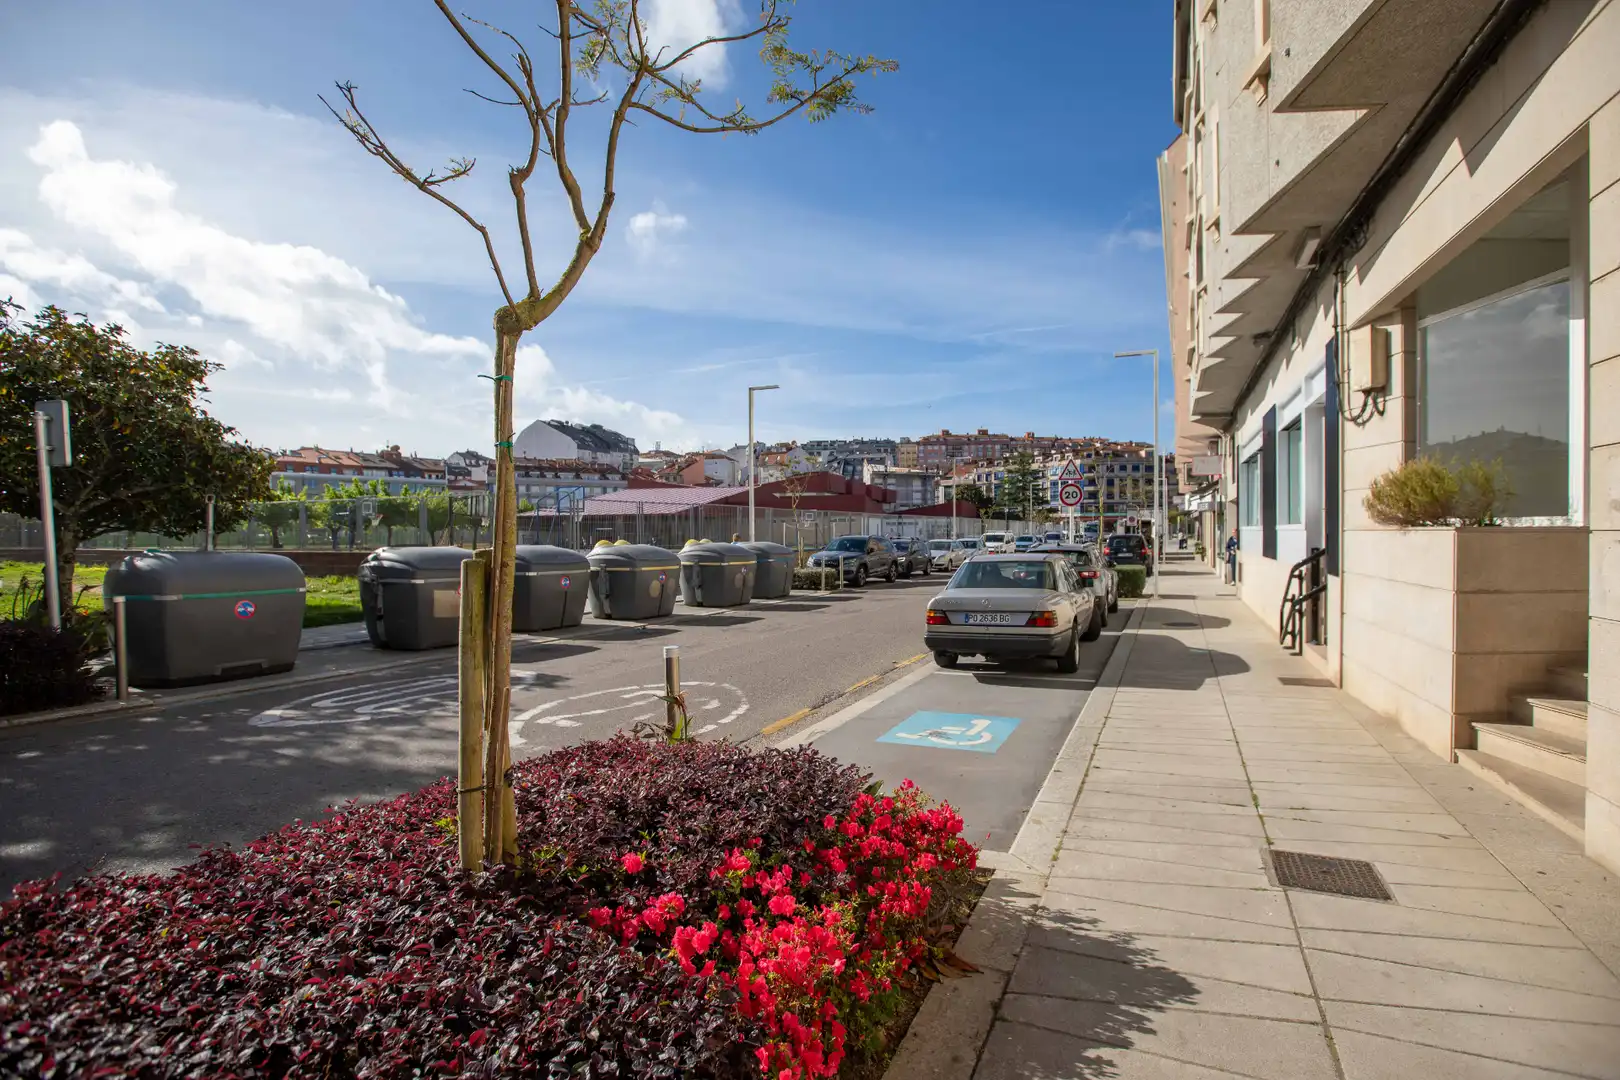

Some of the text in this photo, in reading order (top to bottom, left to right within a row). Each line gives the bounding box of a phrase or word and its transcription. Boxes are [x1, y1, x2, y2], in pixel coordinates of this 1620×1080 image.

[1064, 490, 1078, 499] 20
[969, 614, 1010, 623] PO 2636 BG
